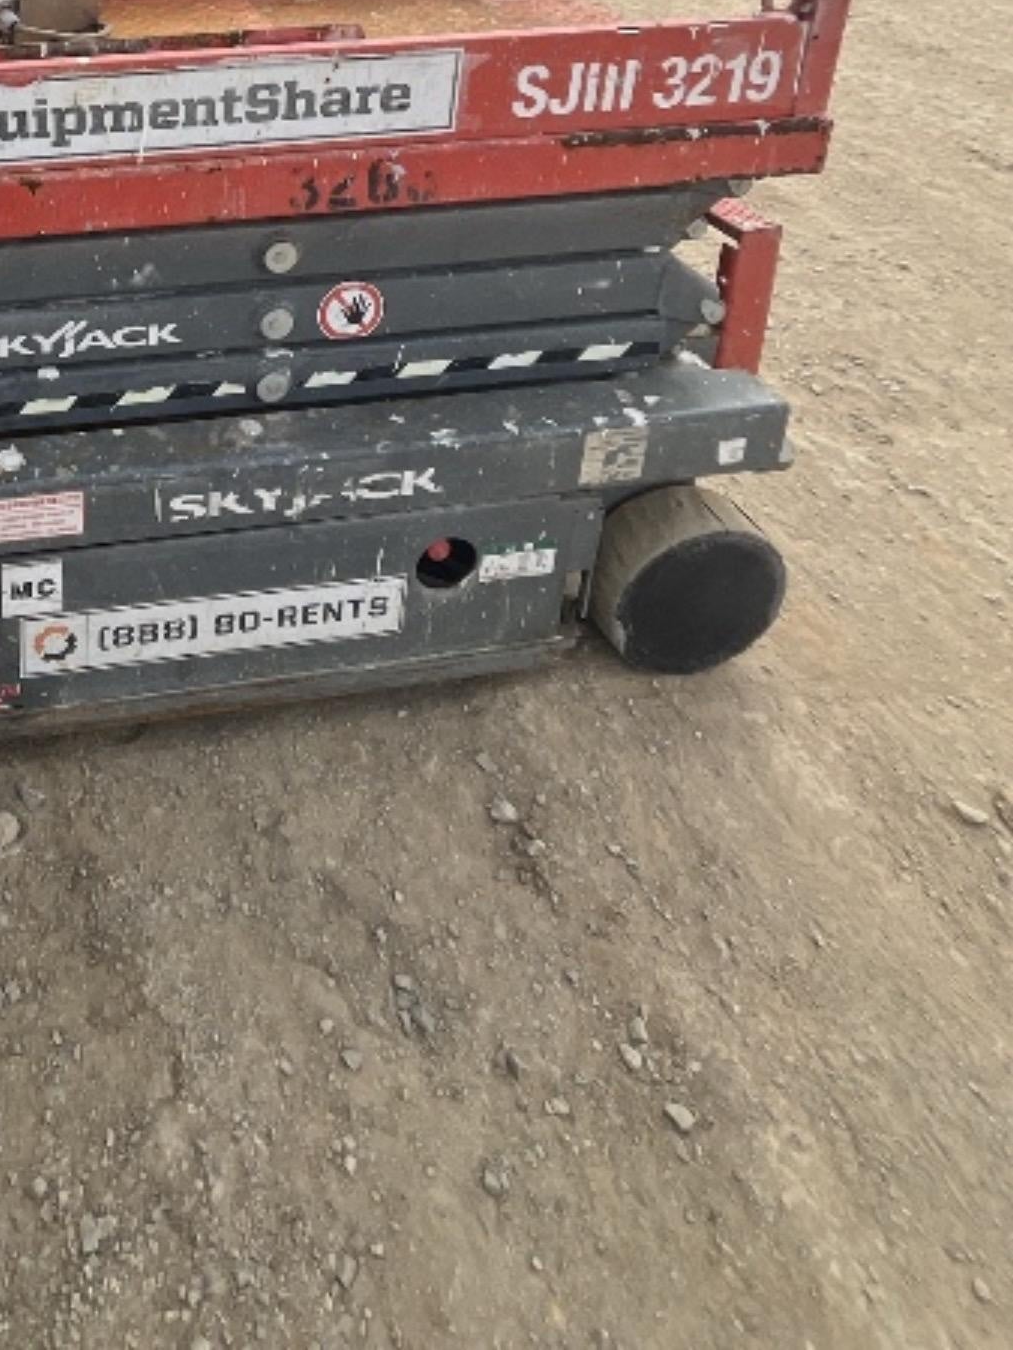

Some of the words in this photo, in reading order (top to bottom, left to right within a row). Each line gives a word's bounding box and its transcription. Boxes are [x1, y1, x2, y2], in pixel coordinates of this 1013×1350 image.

[652, 49, 783, 109] 3219
[10, 578, 56, 600] MC
[99, 615, 199, 653] (888)
[214, 596, 390, 637] 80-RENTS
